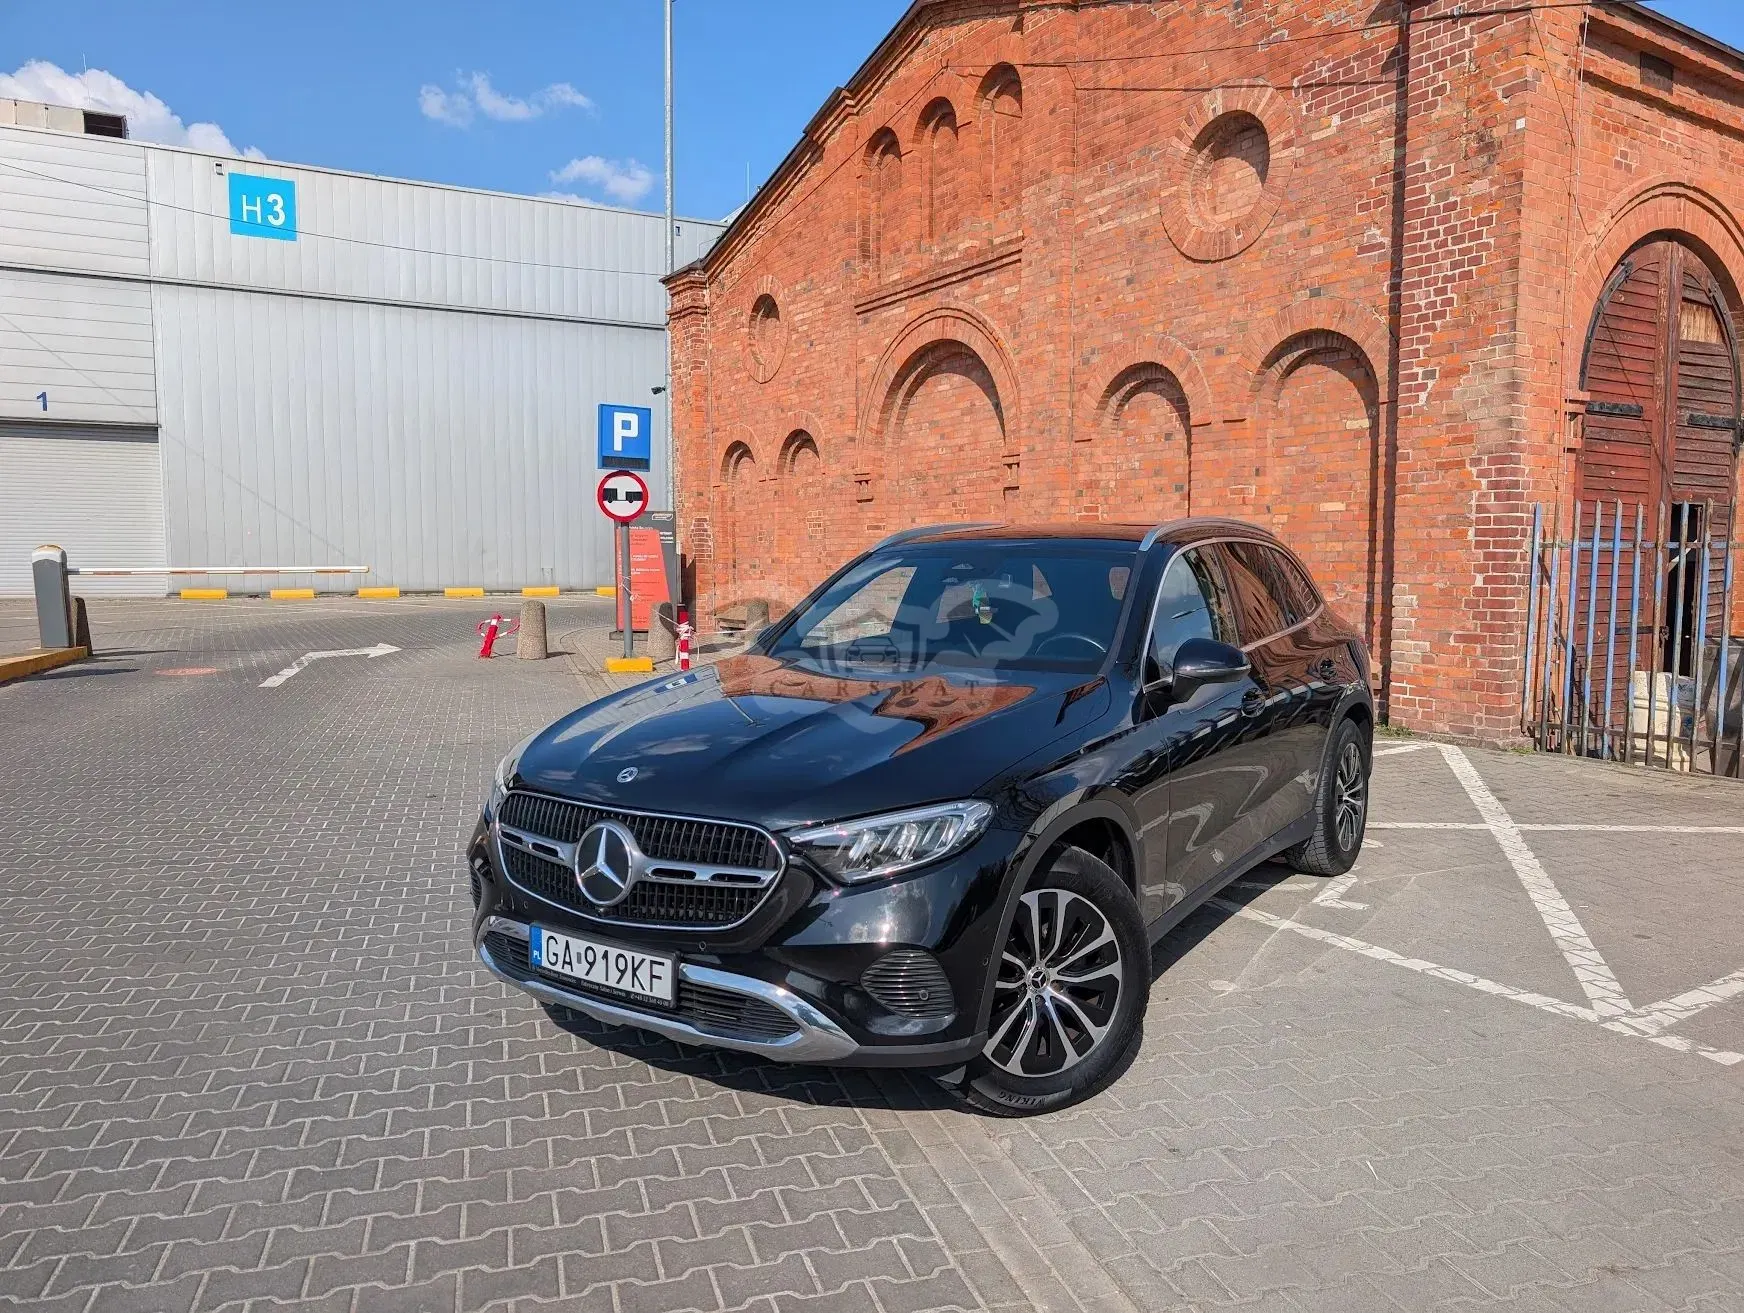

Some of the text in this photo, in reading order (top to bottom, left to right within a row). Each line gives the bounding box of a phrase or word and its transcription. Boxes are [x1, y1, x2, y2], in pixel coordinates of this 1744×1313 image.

[36, 391, 48, 411] 1
[613, 411, 639, 451] P
[533, 949, 541, 960] PL
